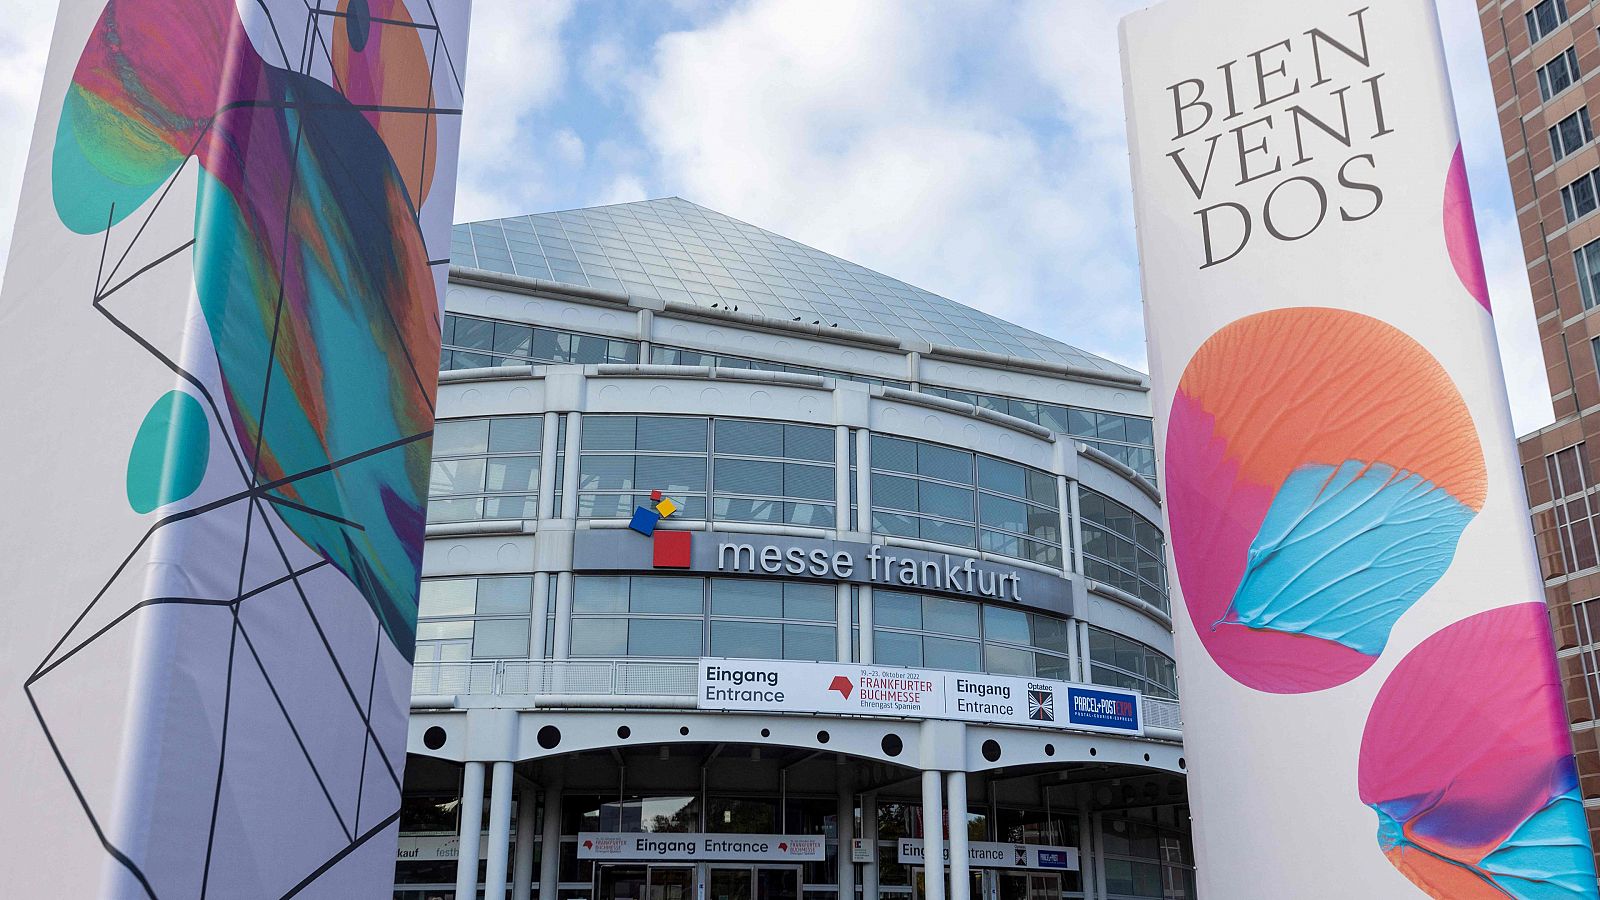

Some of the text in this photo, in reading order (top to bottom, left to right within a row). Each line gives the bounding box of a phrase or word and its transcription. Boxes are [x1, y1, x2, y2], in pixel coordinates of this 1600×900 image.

[1166, 6, 1370, 141] BIEN
[1166, 72, 1394, 200] VENI
[1193, 153, 1384, 270] DOS
[718, 542, 1022, 602] messe frankfurt
[706, 666, 778, 686] Eingang
[882, 671, 906, 679] Oktober
[907, 672, 920, 680] 2022
[860, 677, 933, 692] FRANKFURTER
[956, 679, 1010, 699] Eingang
[1027, 682, 1053, 692] Optatec
[706, 686, 785, 702] Entrance
[860, 688, 921, 703] BUCHMESSE
[860, 700, 921, 711] Ehrengast Spanien
[957, 698, 1014, 715] Entrance
[636, 838, 769, 855] Eingang Entrance
